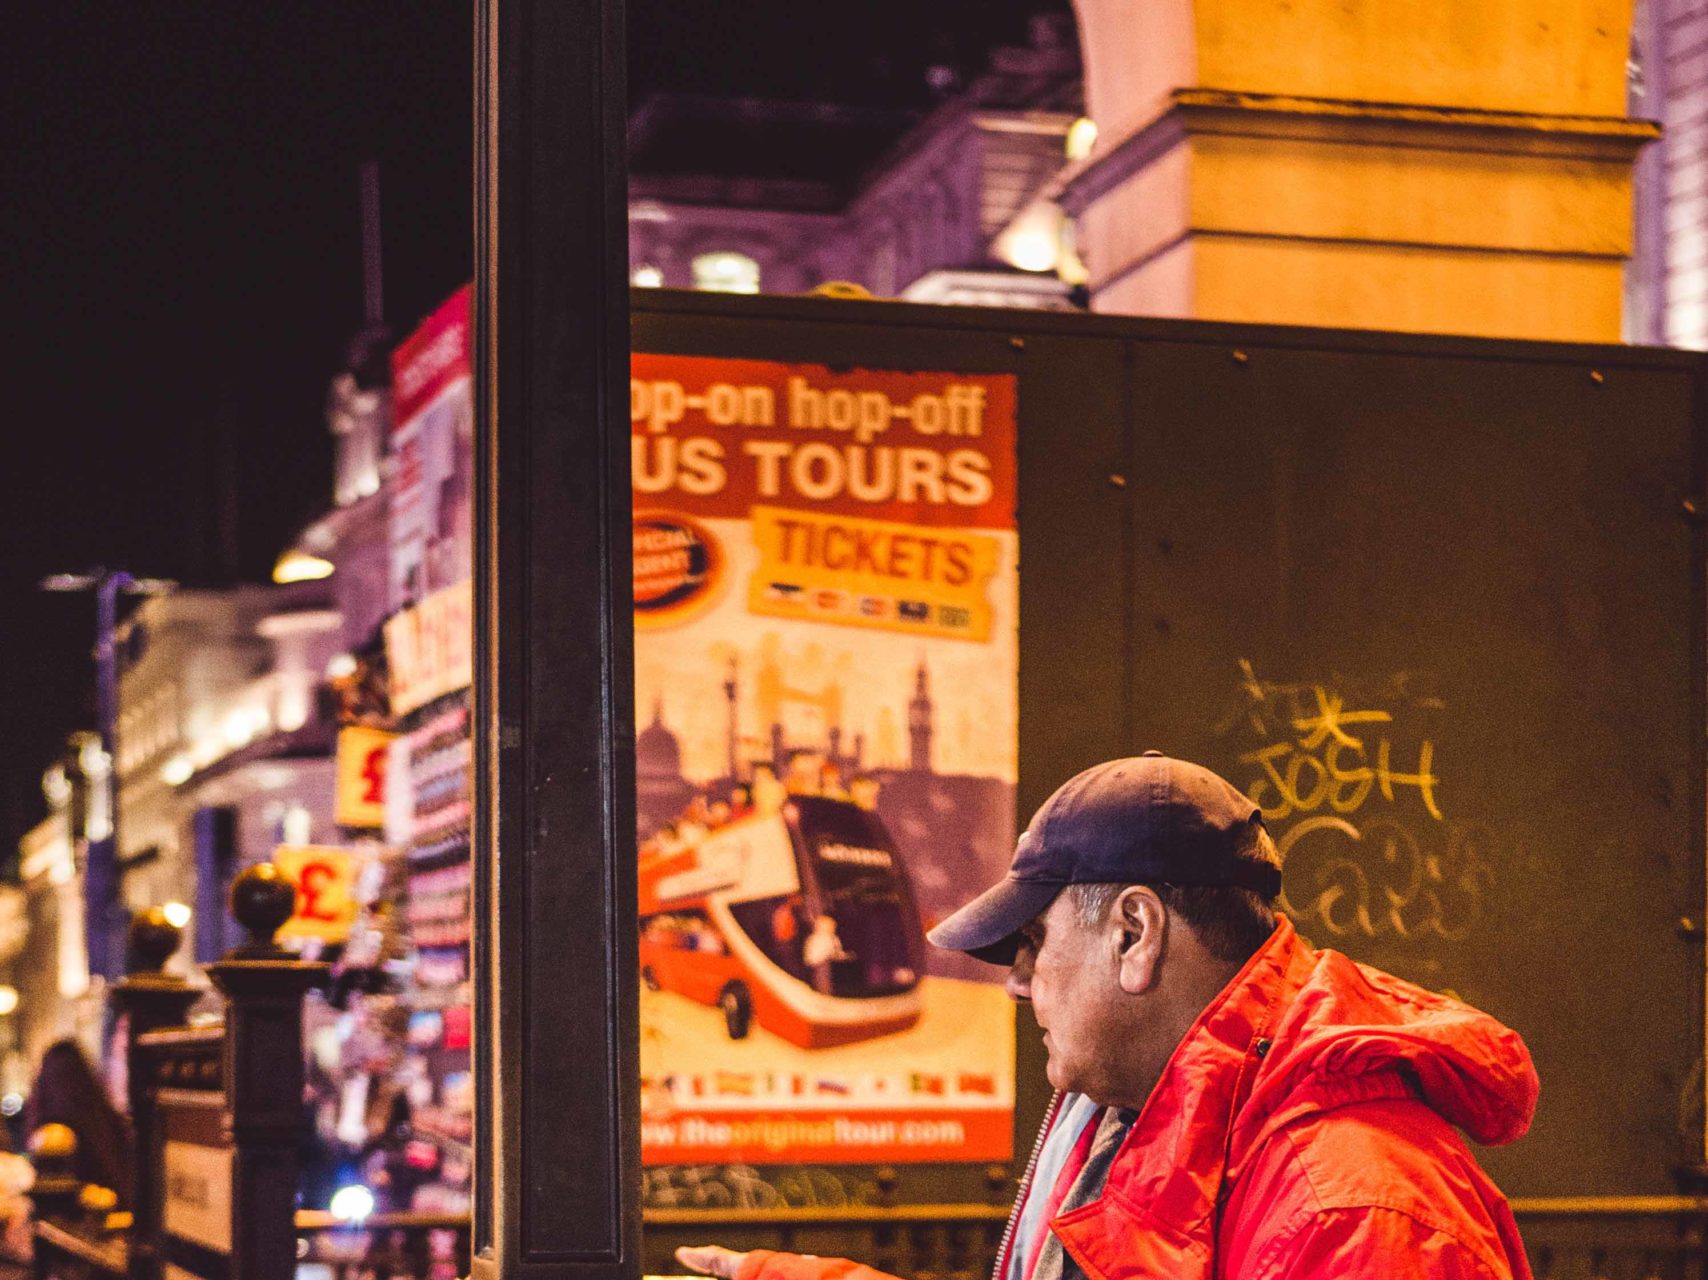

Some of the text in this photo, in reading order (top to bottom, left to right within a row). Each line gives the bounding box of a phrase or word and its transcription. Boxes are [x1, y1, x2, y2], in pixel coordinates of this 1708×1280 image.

[788, 376, 986, 442] hop-off
[632, 433, 994, 506] US TOURS
[776, 519, 974, 587] TICKETS
[1241, 738, 1443, 820] JOSH
